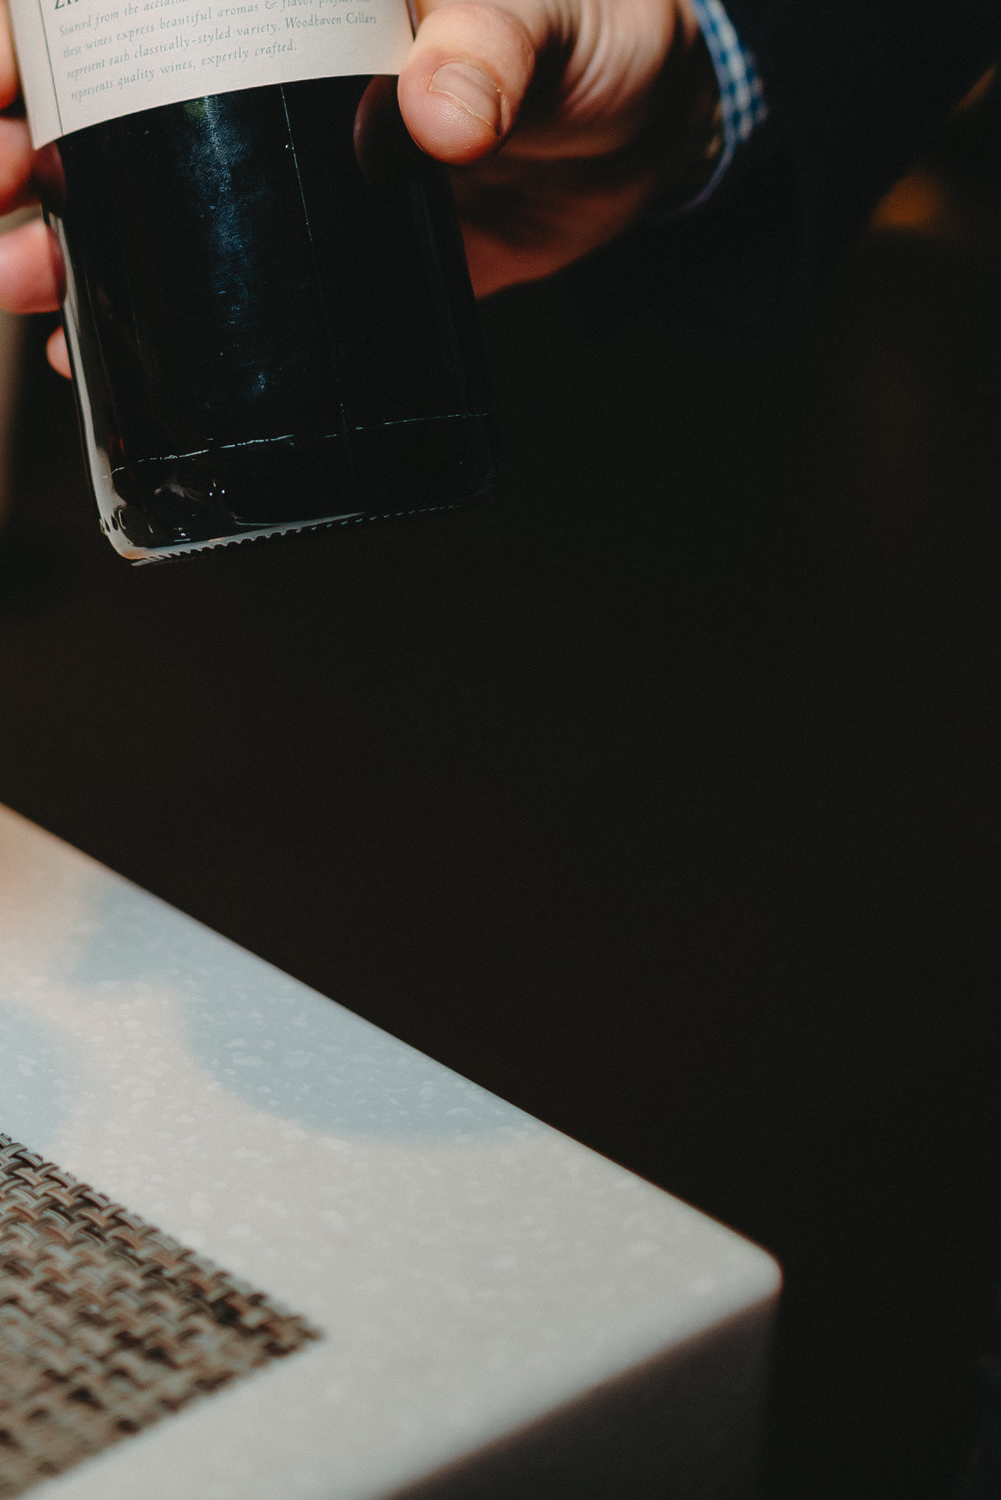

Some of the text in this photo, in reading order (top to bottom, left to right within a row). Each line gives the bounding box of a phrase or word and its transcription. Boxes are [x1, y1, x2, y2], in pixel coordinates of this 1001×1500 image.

[59, 14, 92, 38] Sourced
[94, 11, 119, 29] from
[124, 2, 139, 17] the
[67, 12, 377, 81] represent each classically-styled variety. Woodhaven Cellars
[86, 36, 112, 50] wines
[116, 22, 155, 42] express
[160, 7, 212, 30] beautiful
[217, 3, 259, 18] aromas
[264, 0, 277, 10] &
[71, 38, 296, 102] represents quality wines, expertly crafted.
